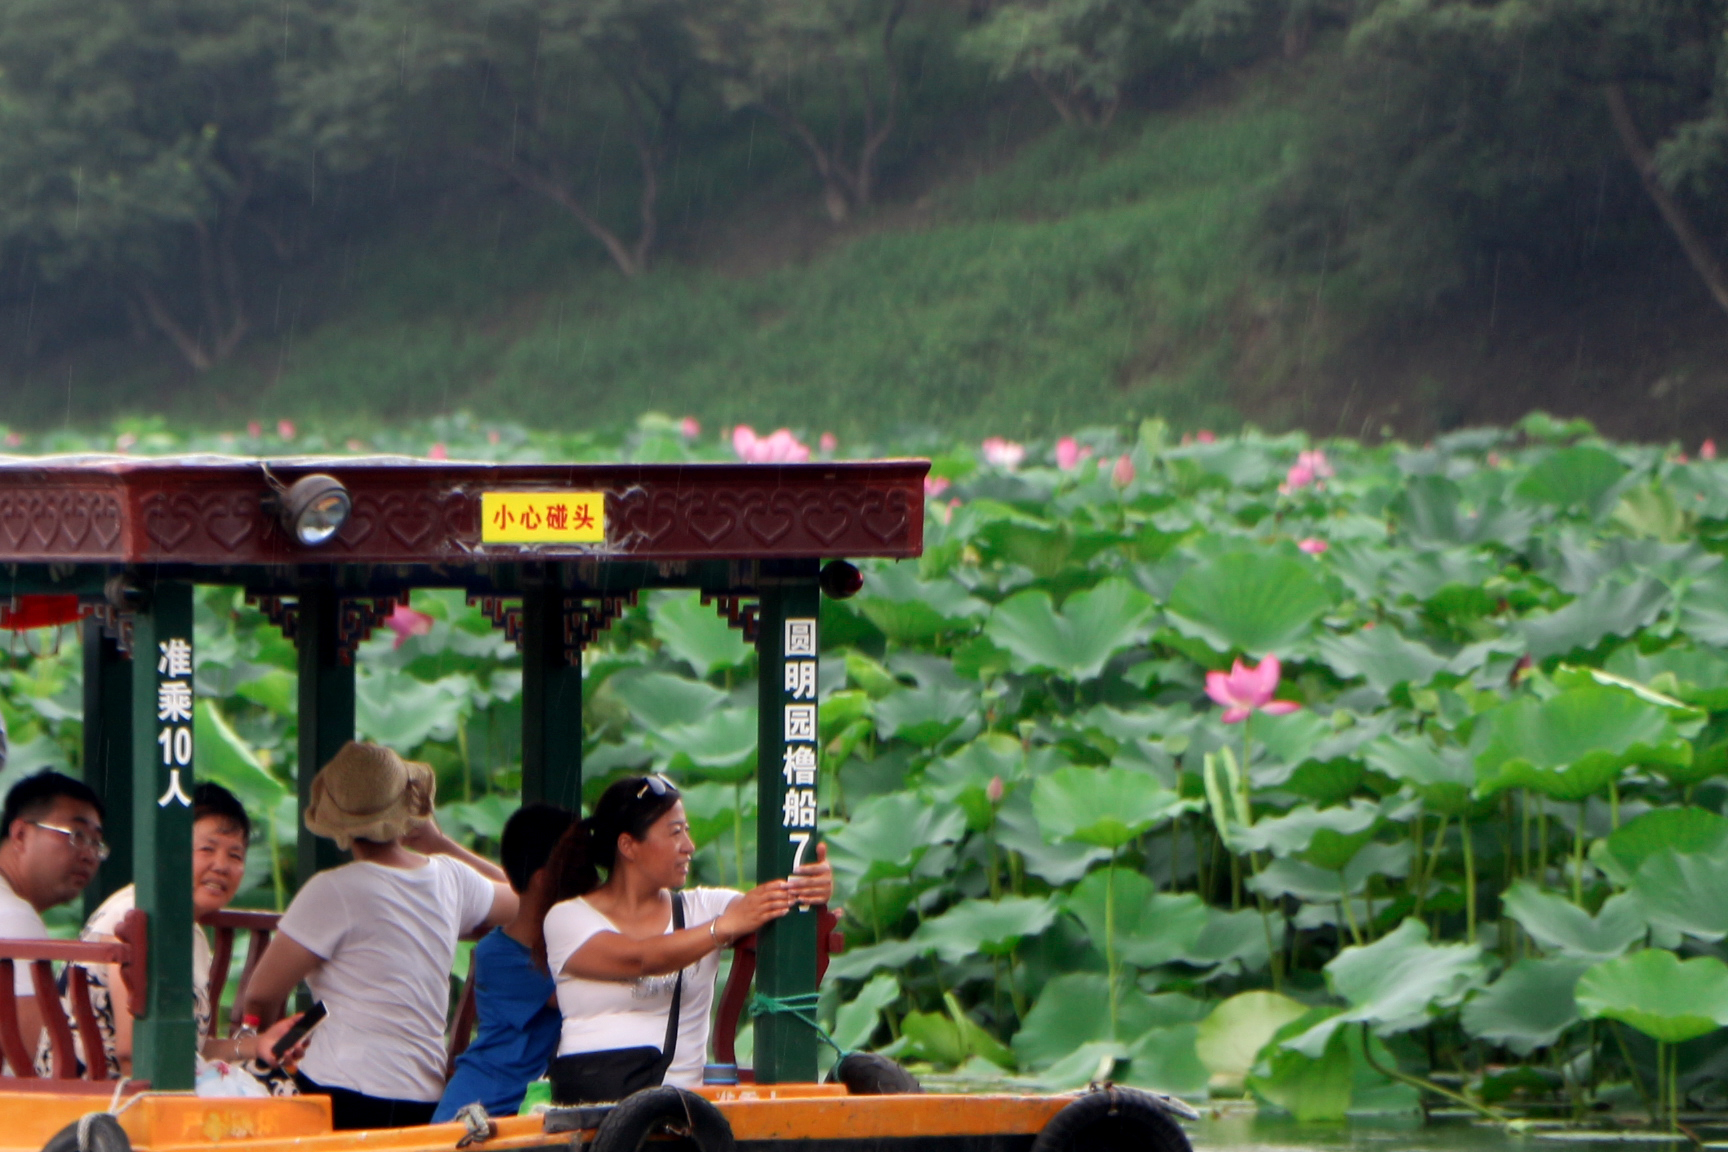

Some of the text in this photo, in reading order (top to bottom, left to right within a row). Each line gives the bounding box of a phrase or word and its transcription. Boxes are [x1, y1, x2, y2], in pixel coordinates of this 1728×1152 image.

[492, 503, 595, 531] 小心碰头
[157, 637, 193, 808] 准乘10人
[782, 617, 817, 912] 圆明园橹船7
